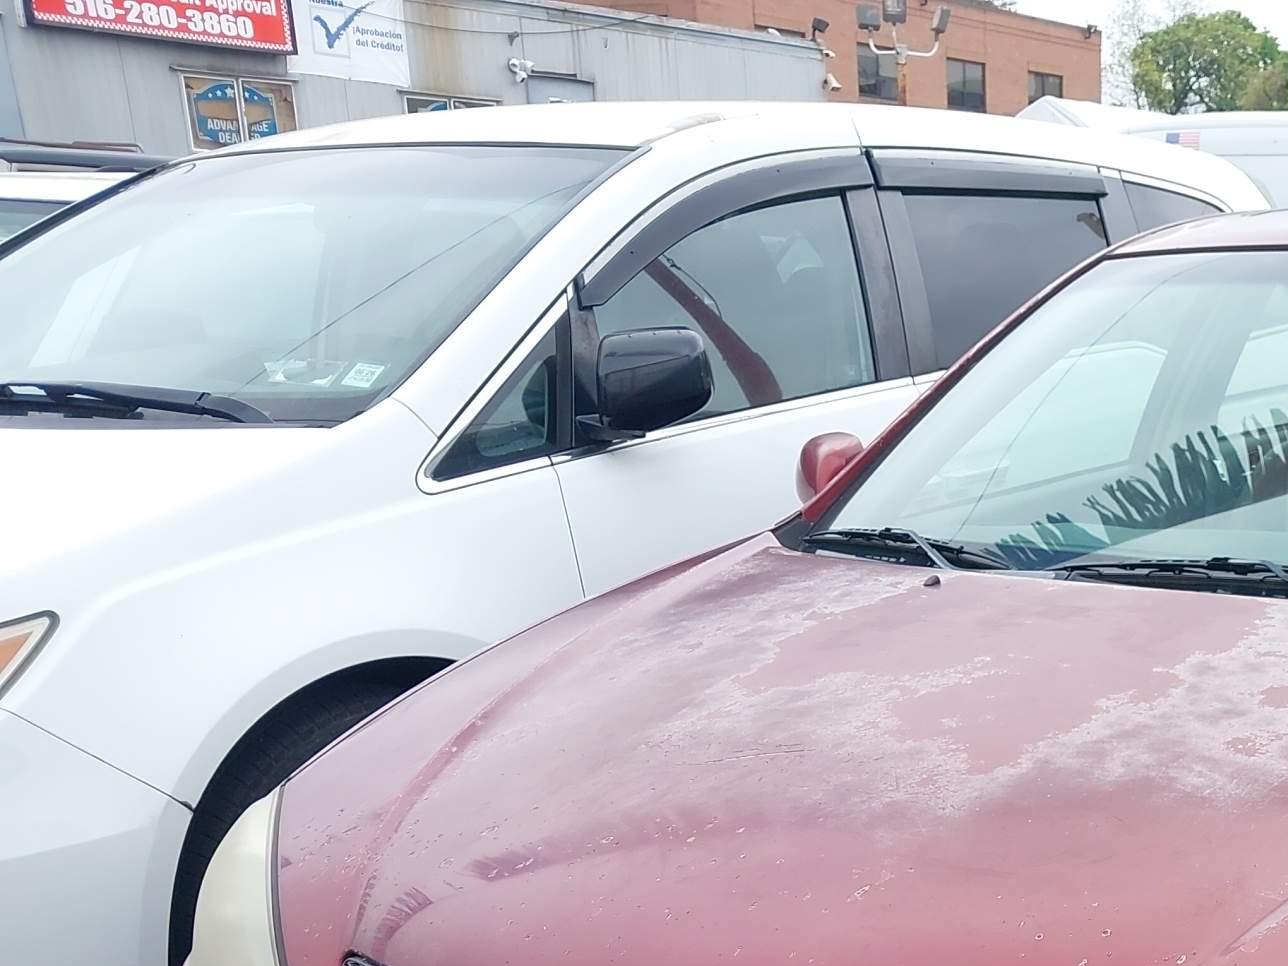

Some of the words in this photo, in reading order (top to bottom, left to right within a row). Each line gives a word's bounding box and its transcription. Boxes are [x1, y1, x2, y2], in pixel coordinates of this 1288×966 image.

[65, 0, 254, 38] 516-280-3860
[355, 38, 369, 47] del
[207, 118, 272, 132] ADVANAGE
